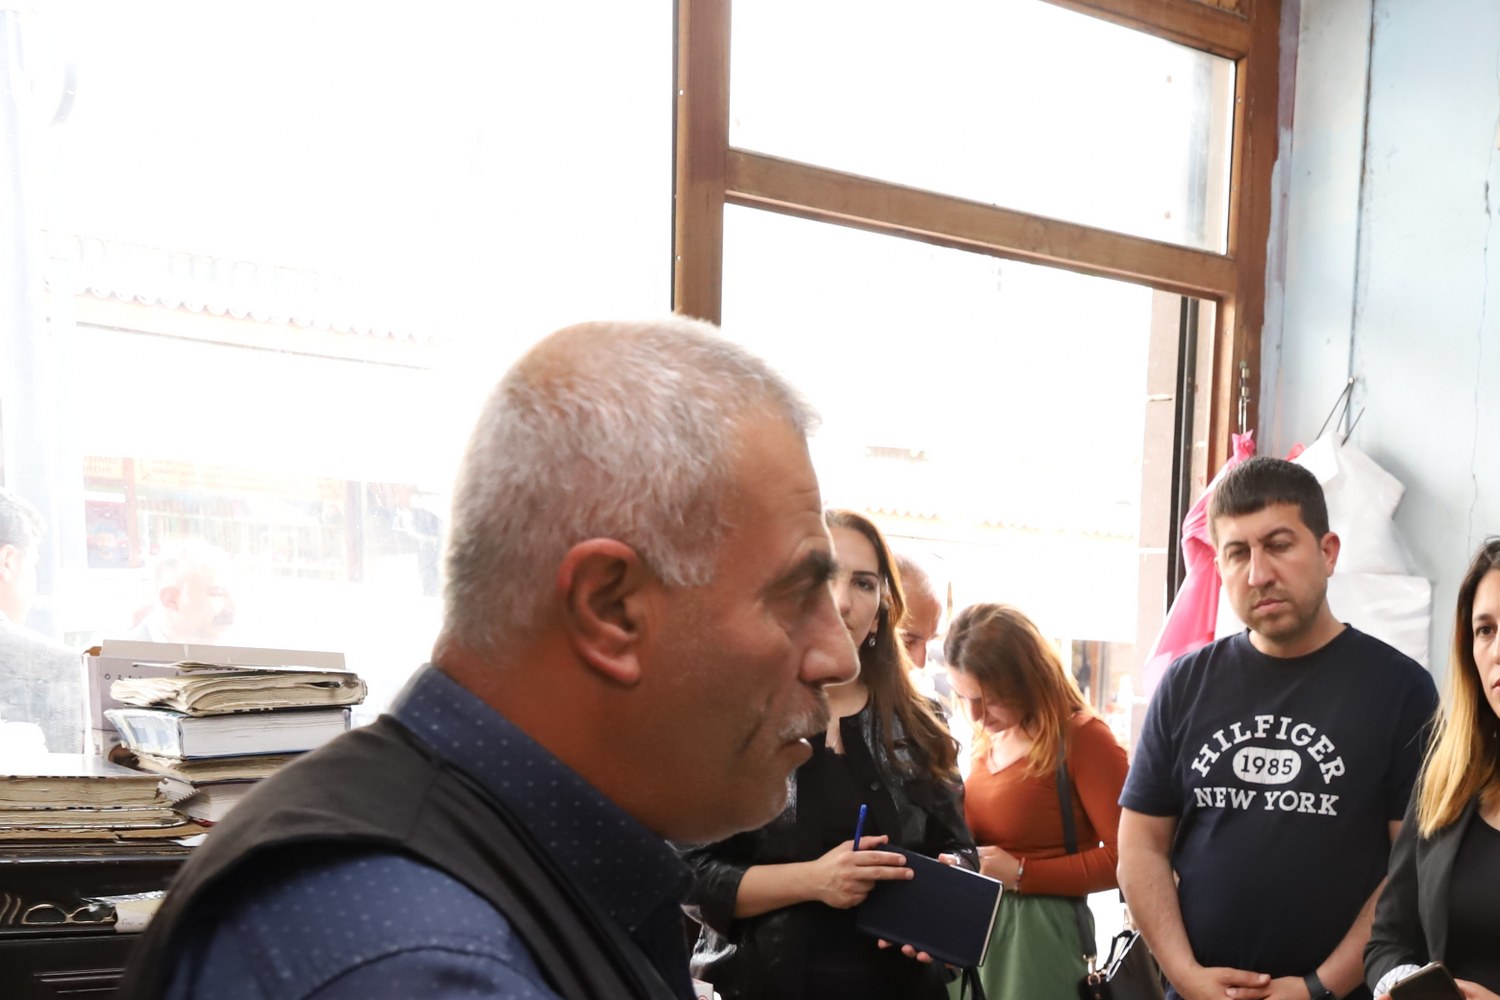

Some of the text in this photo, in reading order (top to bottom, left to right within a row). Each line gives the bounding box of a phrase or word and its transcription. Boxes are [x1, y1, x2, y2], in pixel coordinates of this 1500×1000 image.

[1191, 714, 1346, 784] HILFIGER
[1240, 755, 1294, 775] 1985
[1193, 787, 1340, 816] NEW YORK
